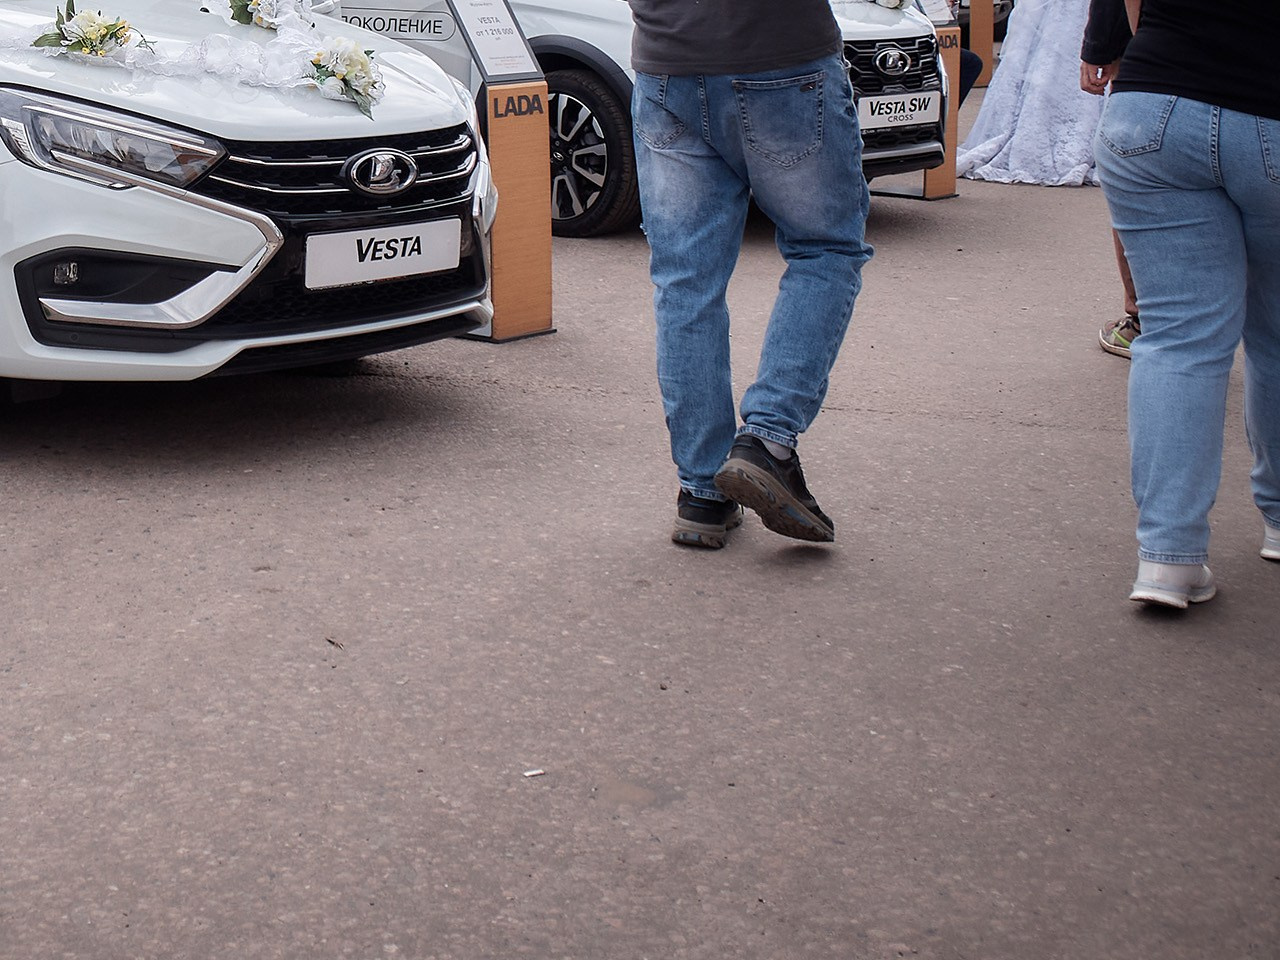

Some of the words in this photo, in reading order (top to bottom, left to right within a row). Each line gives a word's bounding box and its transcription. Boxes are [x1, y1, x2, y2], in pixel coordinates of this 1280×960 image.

[477, 16, 500, 24] VESTA
[938, 34, 959, 49] ADA
[493, 94, 544, 119] LADA
[869, 100, 907, 117] VESTA
[908, 97, 932, 113] SW
[887, 113, 914, 123] CROSS
[355, 235, 423, 263] VESTA
